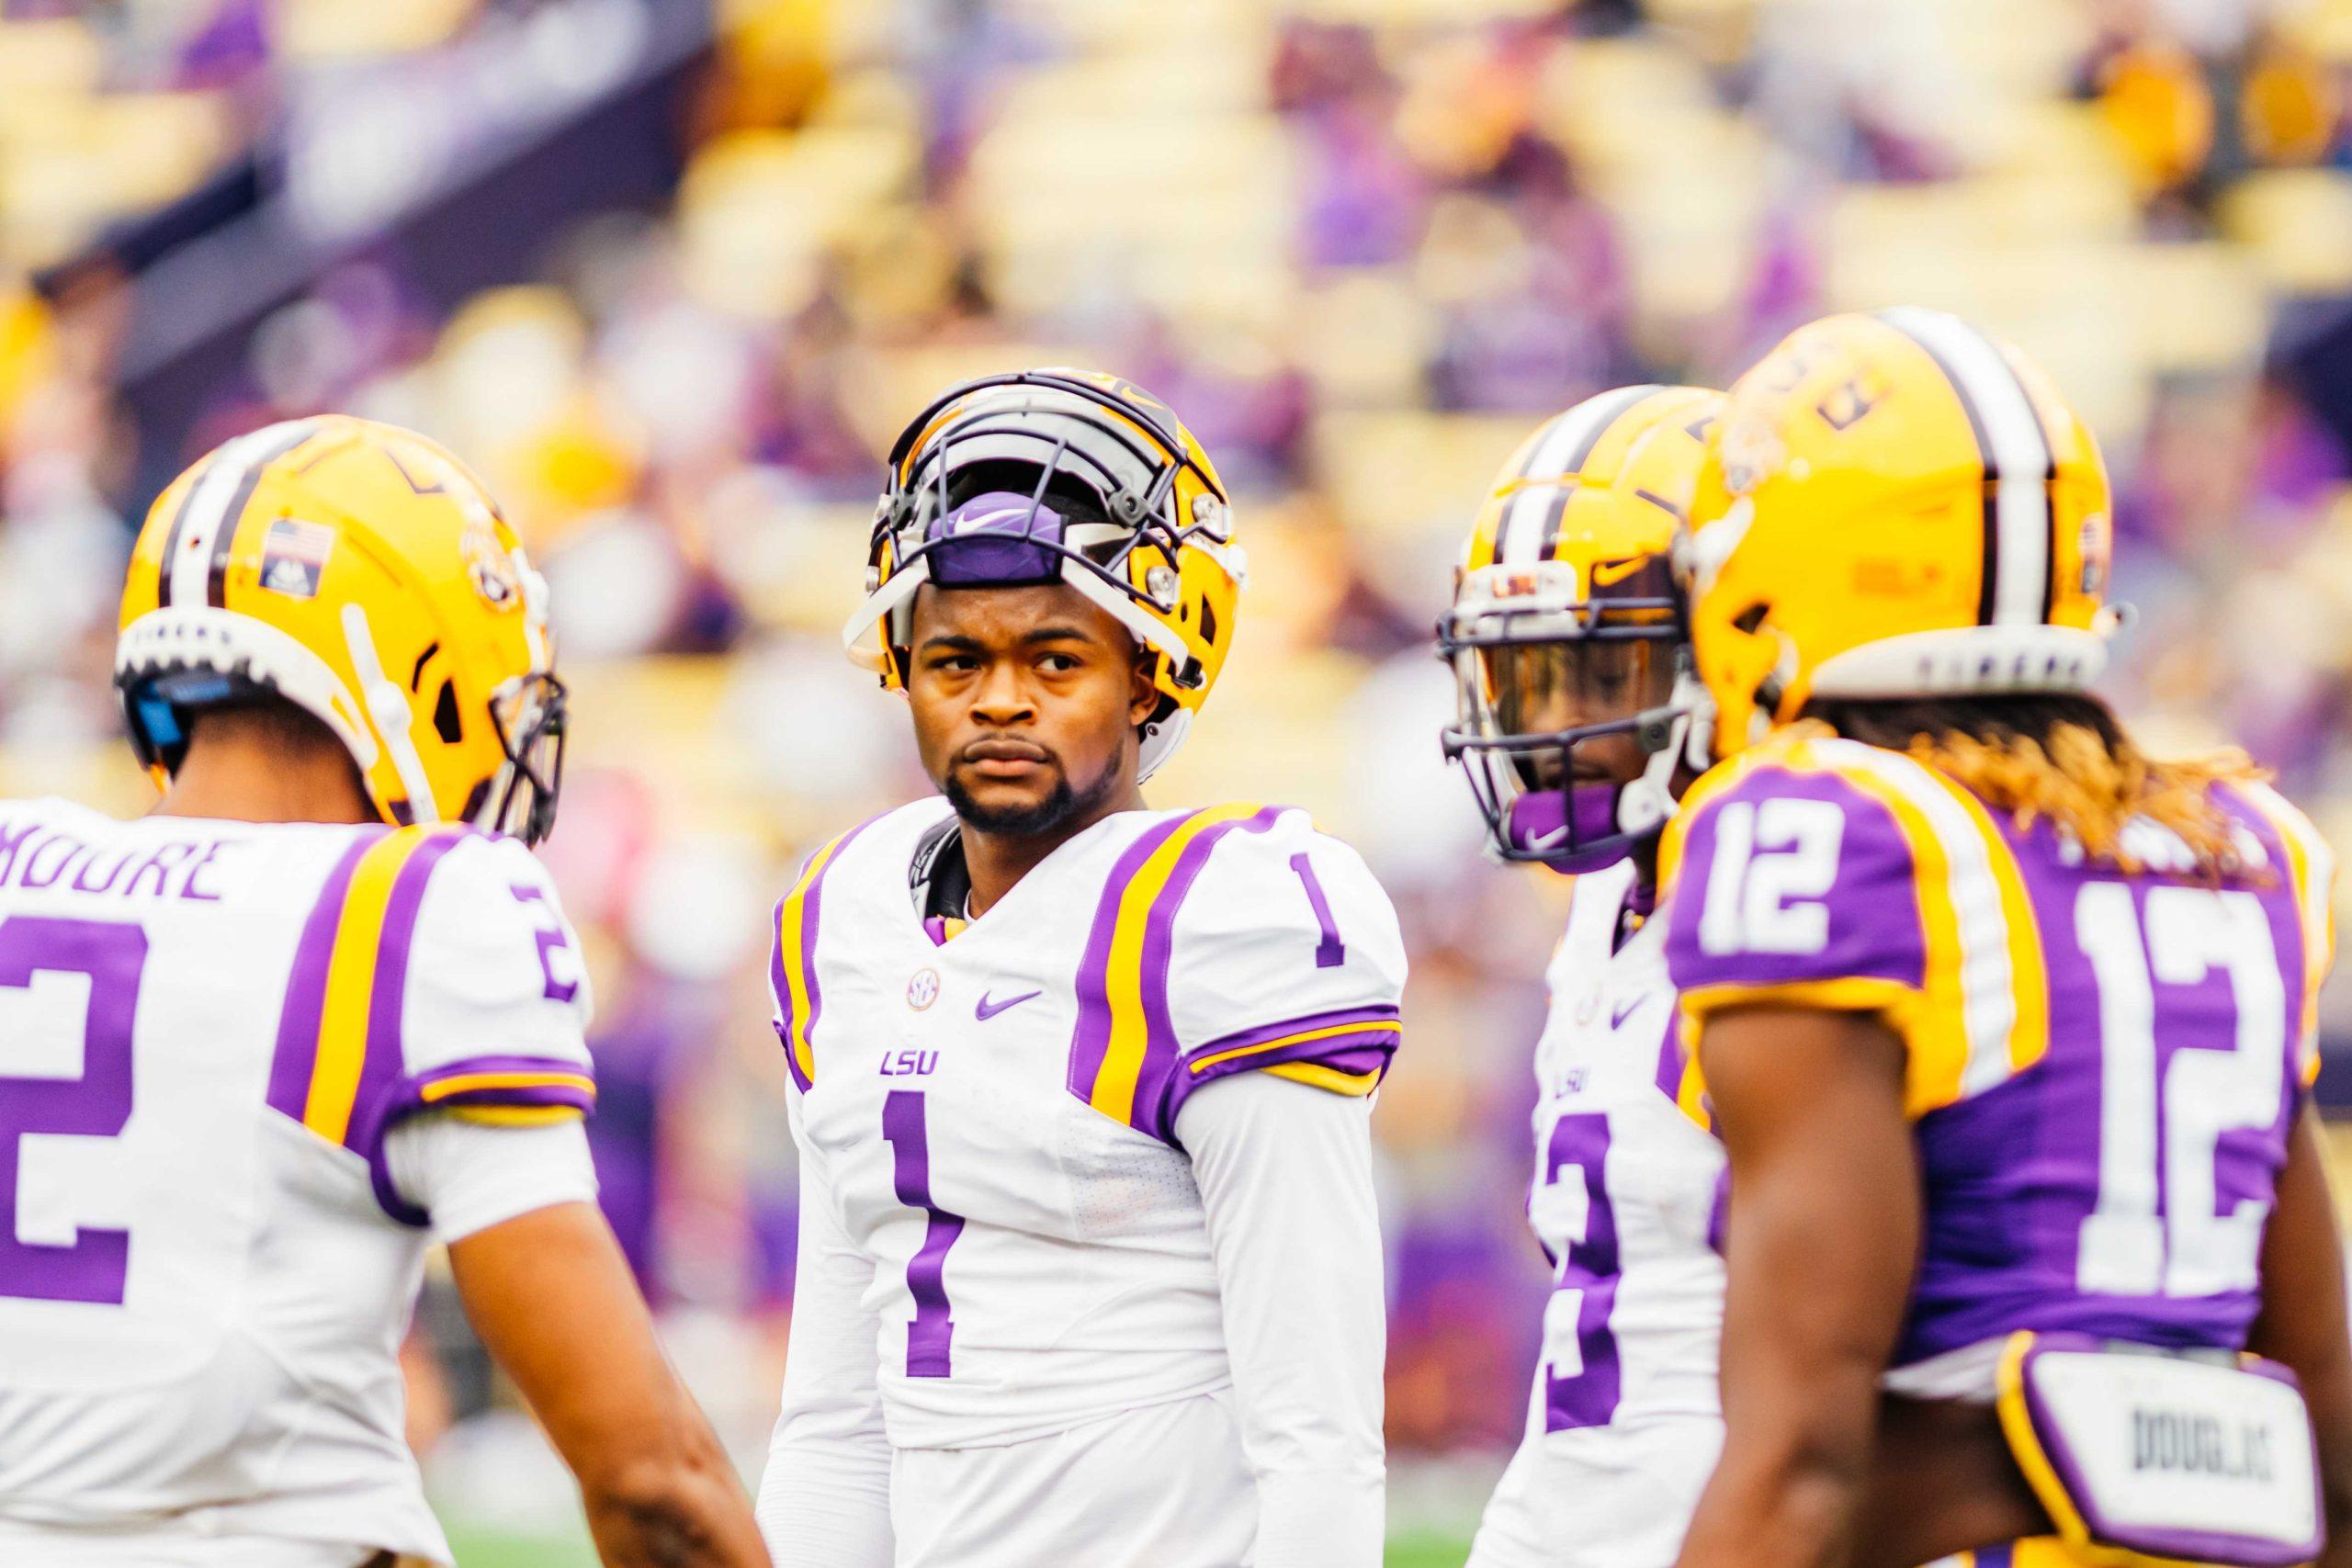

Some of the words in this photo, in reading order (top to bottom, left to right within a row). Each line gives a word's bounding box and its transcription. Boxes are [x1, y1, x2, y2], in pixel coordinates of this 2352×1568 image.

[1290, 852, 1344, 967] 1
[1699, 797, 1846, 957] 12
[509, 884, 577, 1003] 2
[879, 1050, 939, 1076] LSU
[2075, 881, 2285, 1297] 12
[882, 1089, 966, 1378] 1
[2133, 1409, 2273, 1483] DOUGS
